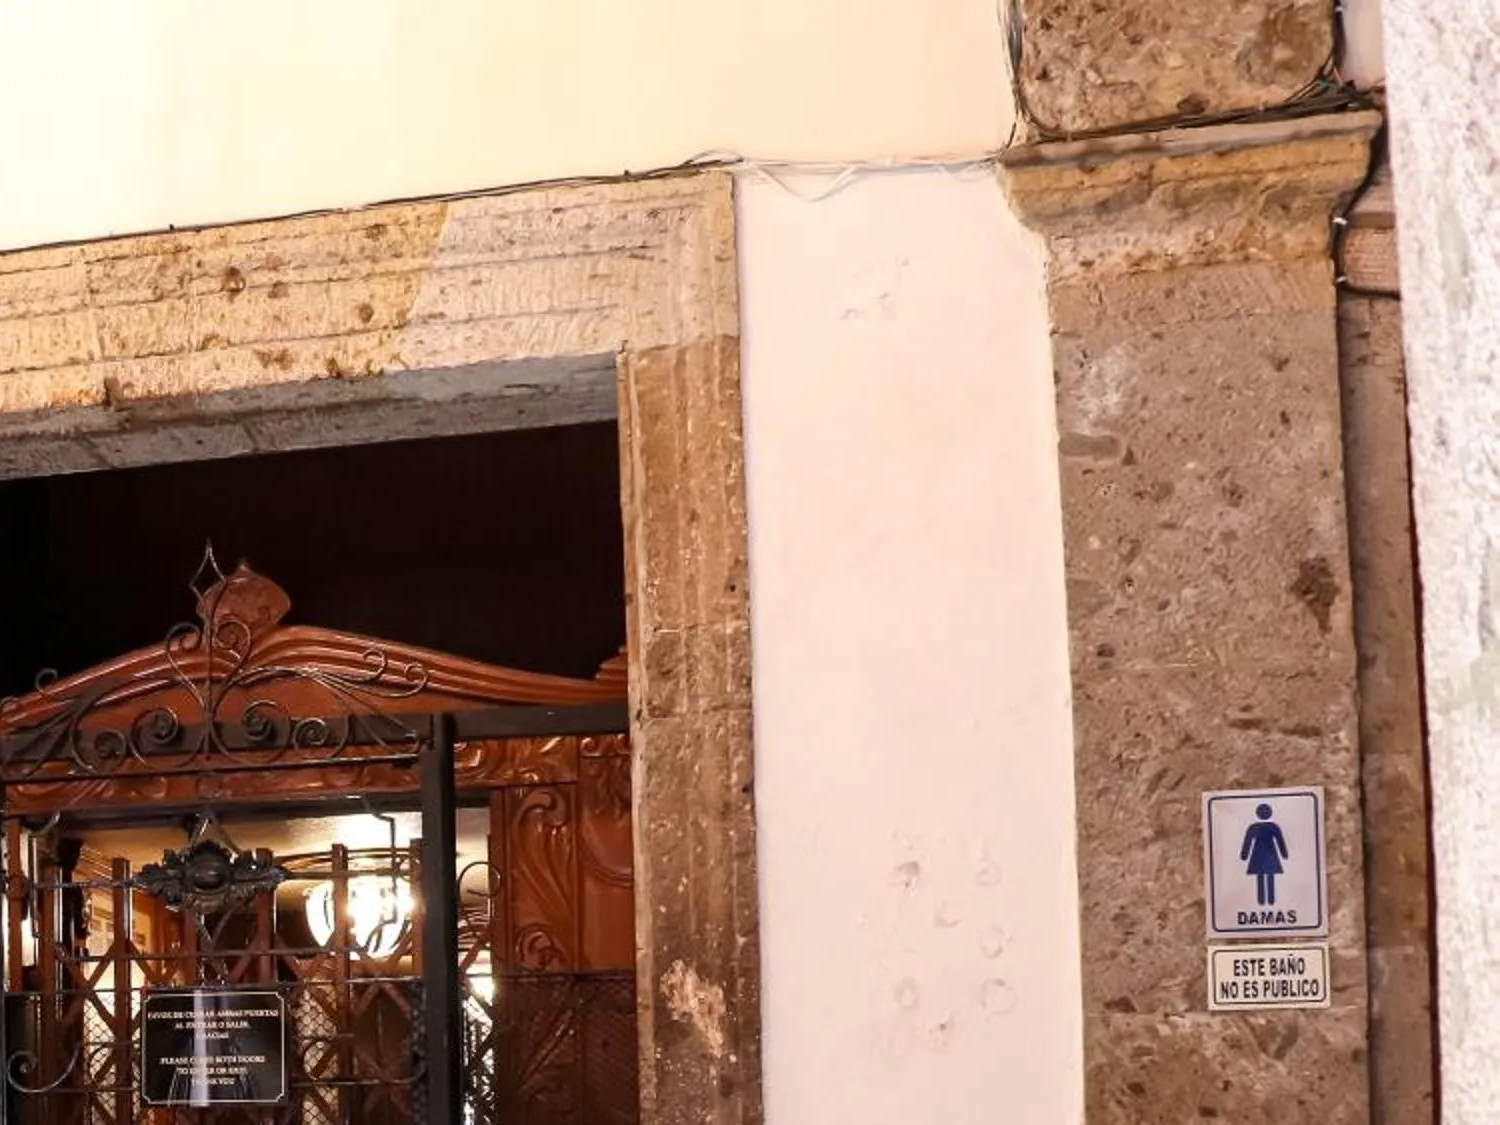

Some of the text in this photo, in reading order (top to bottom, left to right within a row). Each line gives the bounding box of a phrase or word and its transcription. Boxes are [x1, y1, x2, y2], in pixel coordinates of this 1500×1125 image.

[1237, 910, 1298, 925] DAMAS
[1233, 954, 1305, 977] ESTE BAÑO
[1220, 979, 1319, 999] NO ES PUBLICO
